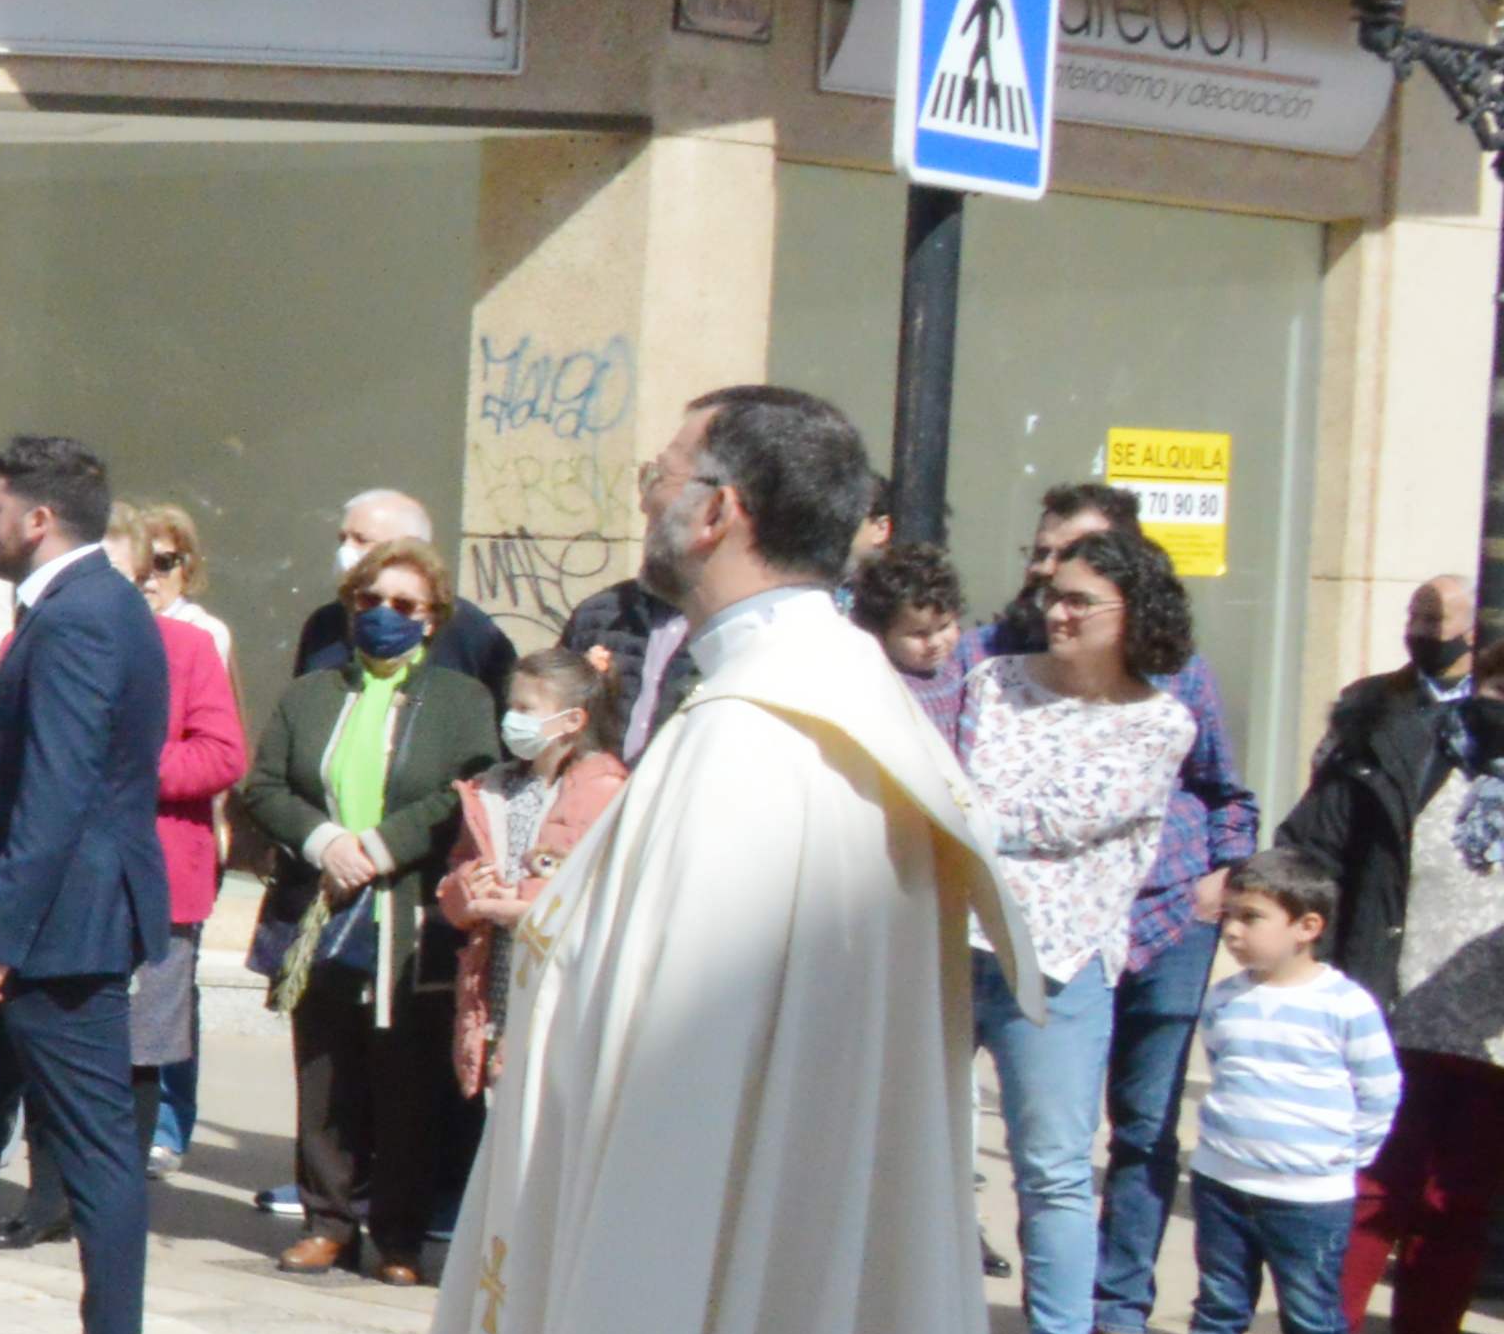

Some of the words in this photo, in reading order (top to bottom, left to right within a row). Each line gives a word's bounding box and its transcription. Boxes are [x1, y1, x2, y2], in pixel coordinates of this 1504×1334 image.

[1168, 78, 1185, 106] y
[1188, 79, 1314, 120] decoración
[1113, 442, 1137, 466] SE
[1142, 444, 1223, 470] ALQUILA
[1149, 492, 1167, 514] 70
[1174, 493, 1193, 516] 90
